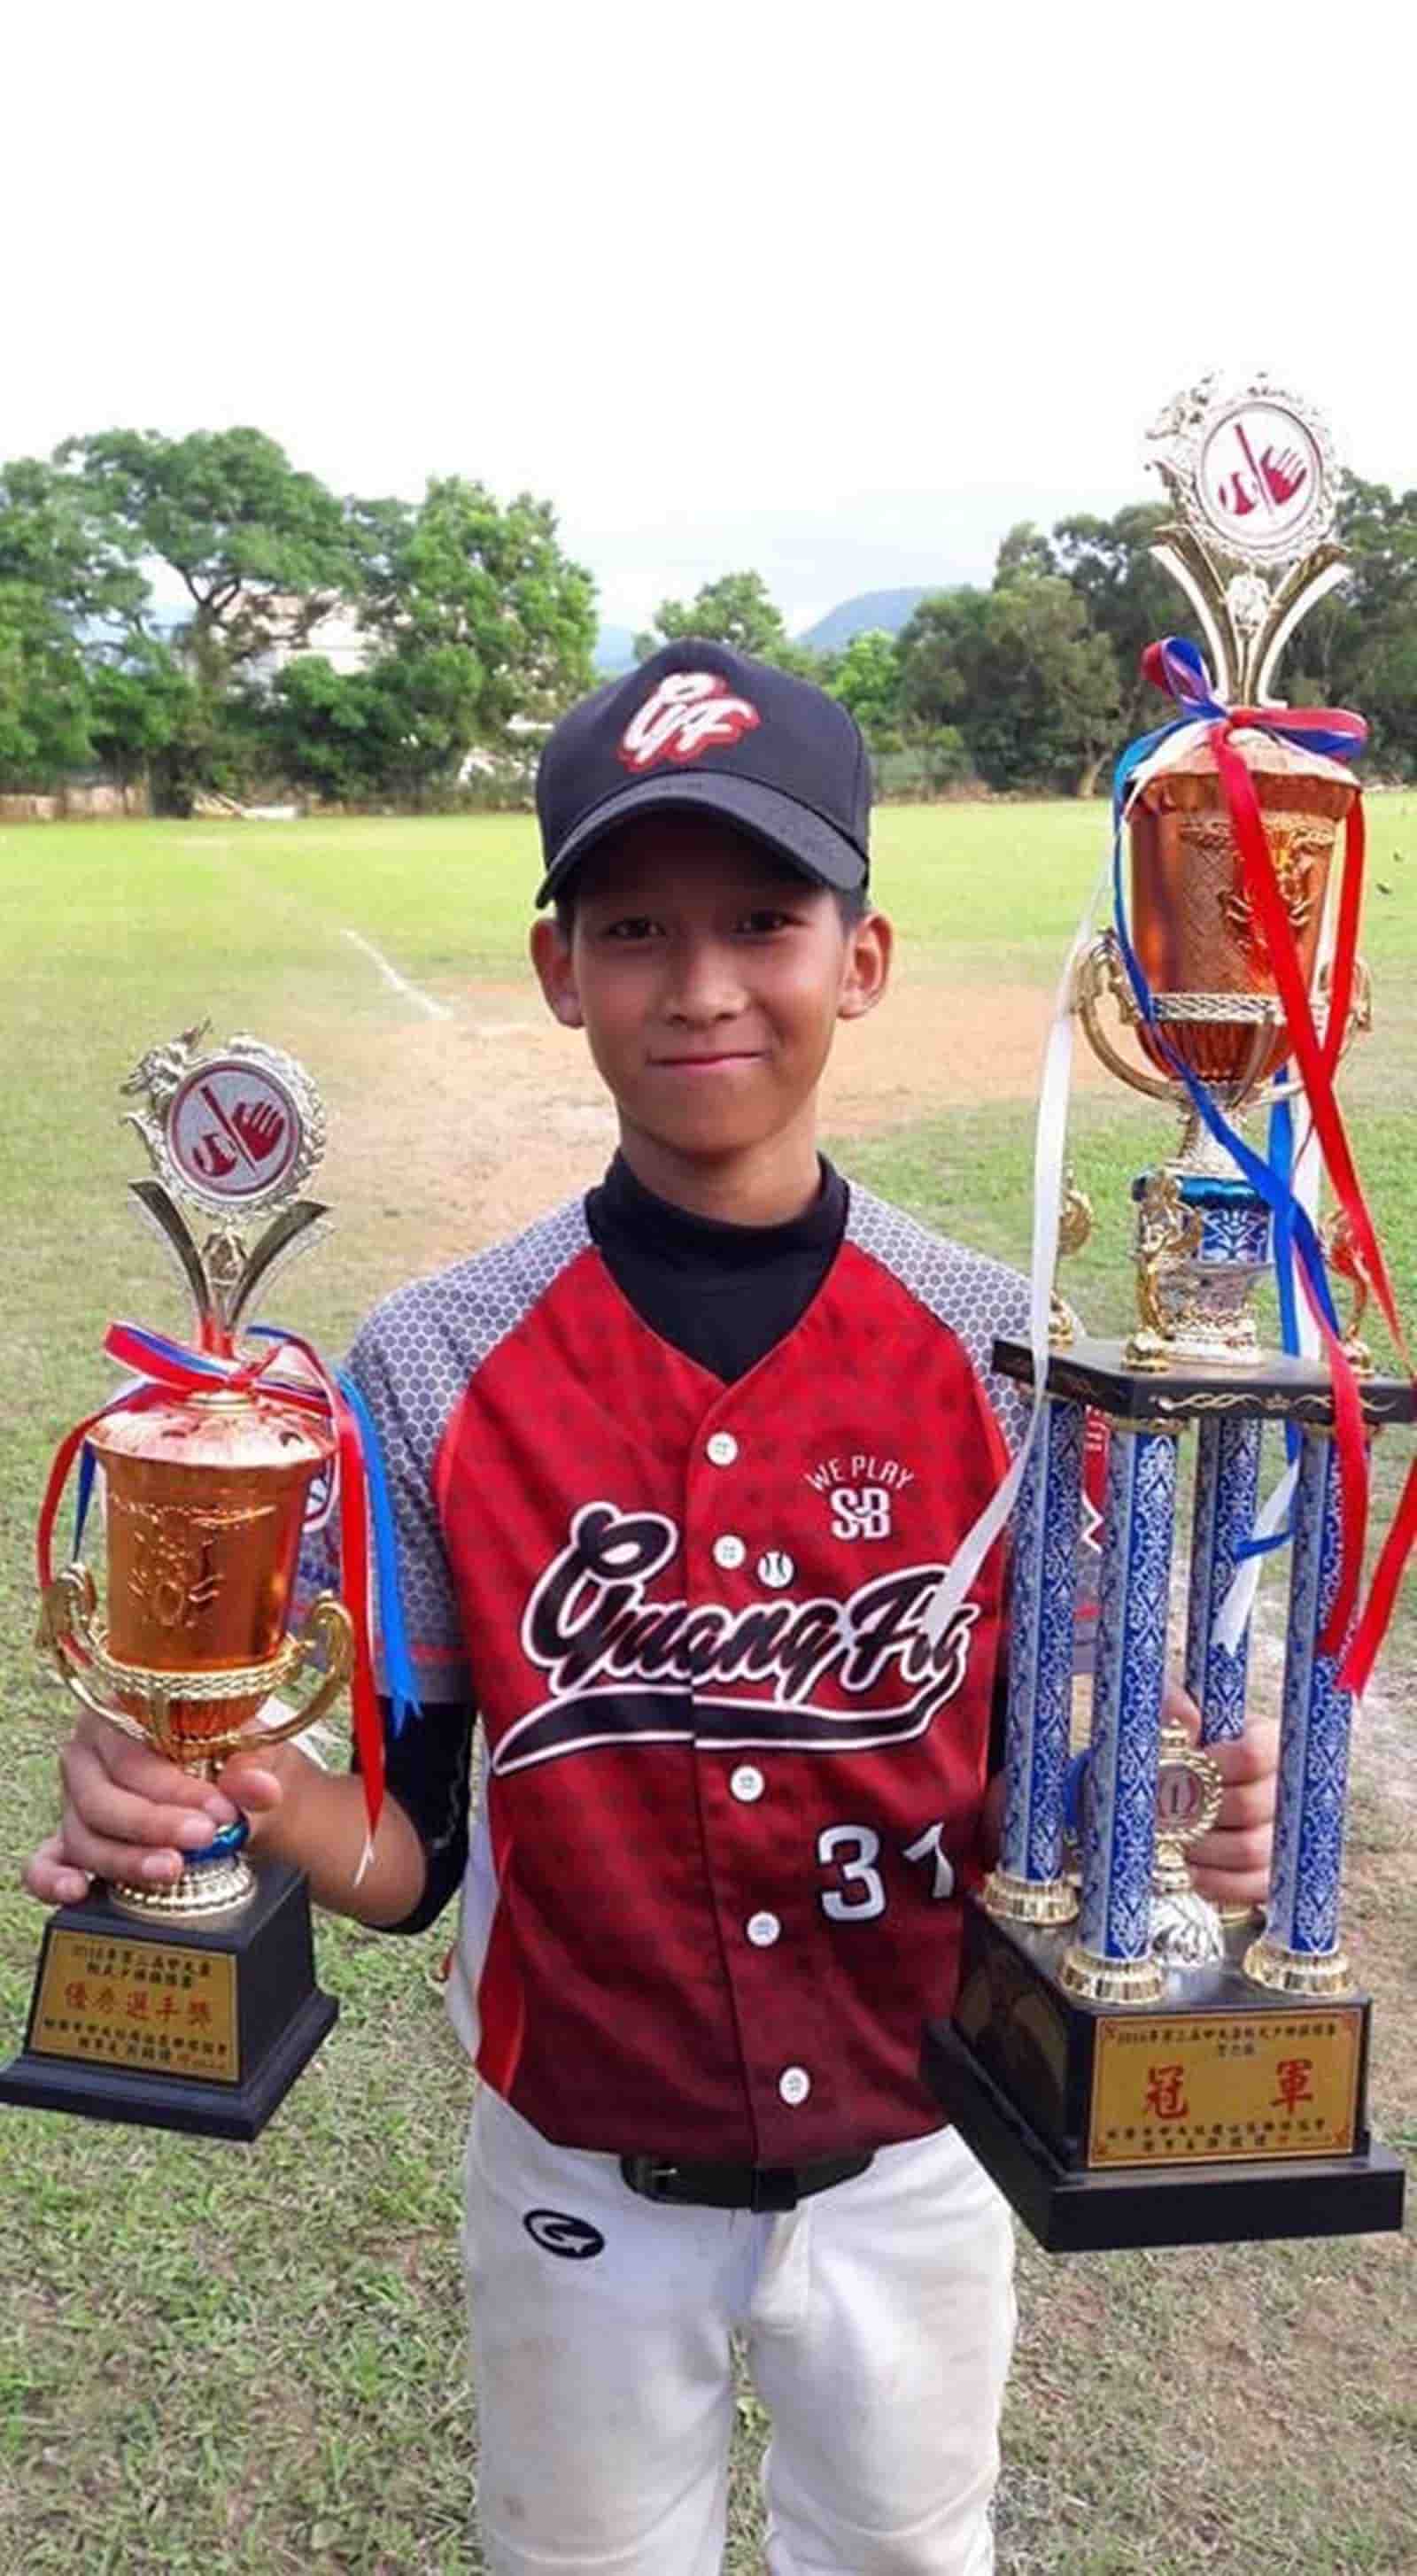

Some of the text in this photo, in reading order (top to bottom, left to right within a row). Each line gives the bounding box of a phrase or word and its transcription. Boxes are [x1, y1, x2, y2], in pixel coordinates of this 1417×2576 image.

[802, 1454, 915, 1492] WE PLAY
[830, 1487, 892, 1541] SB
